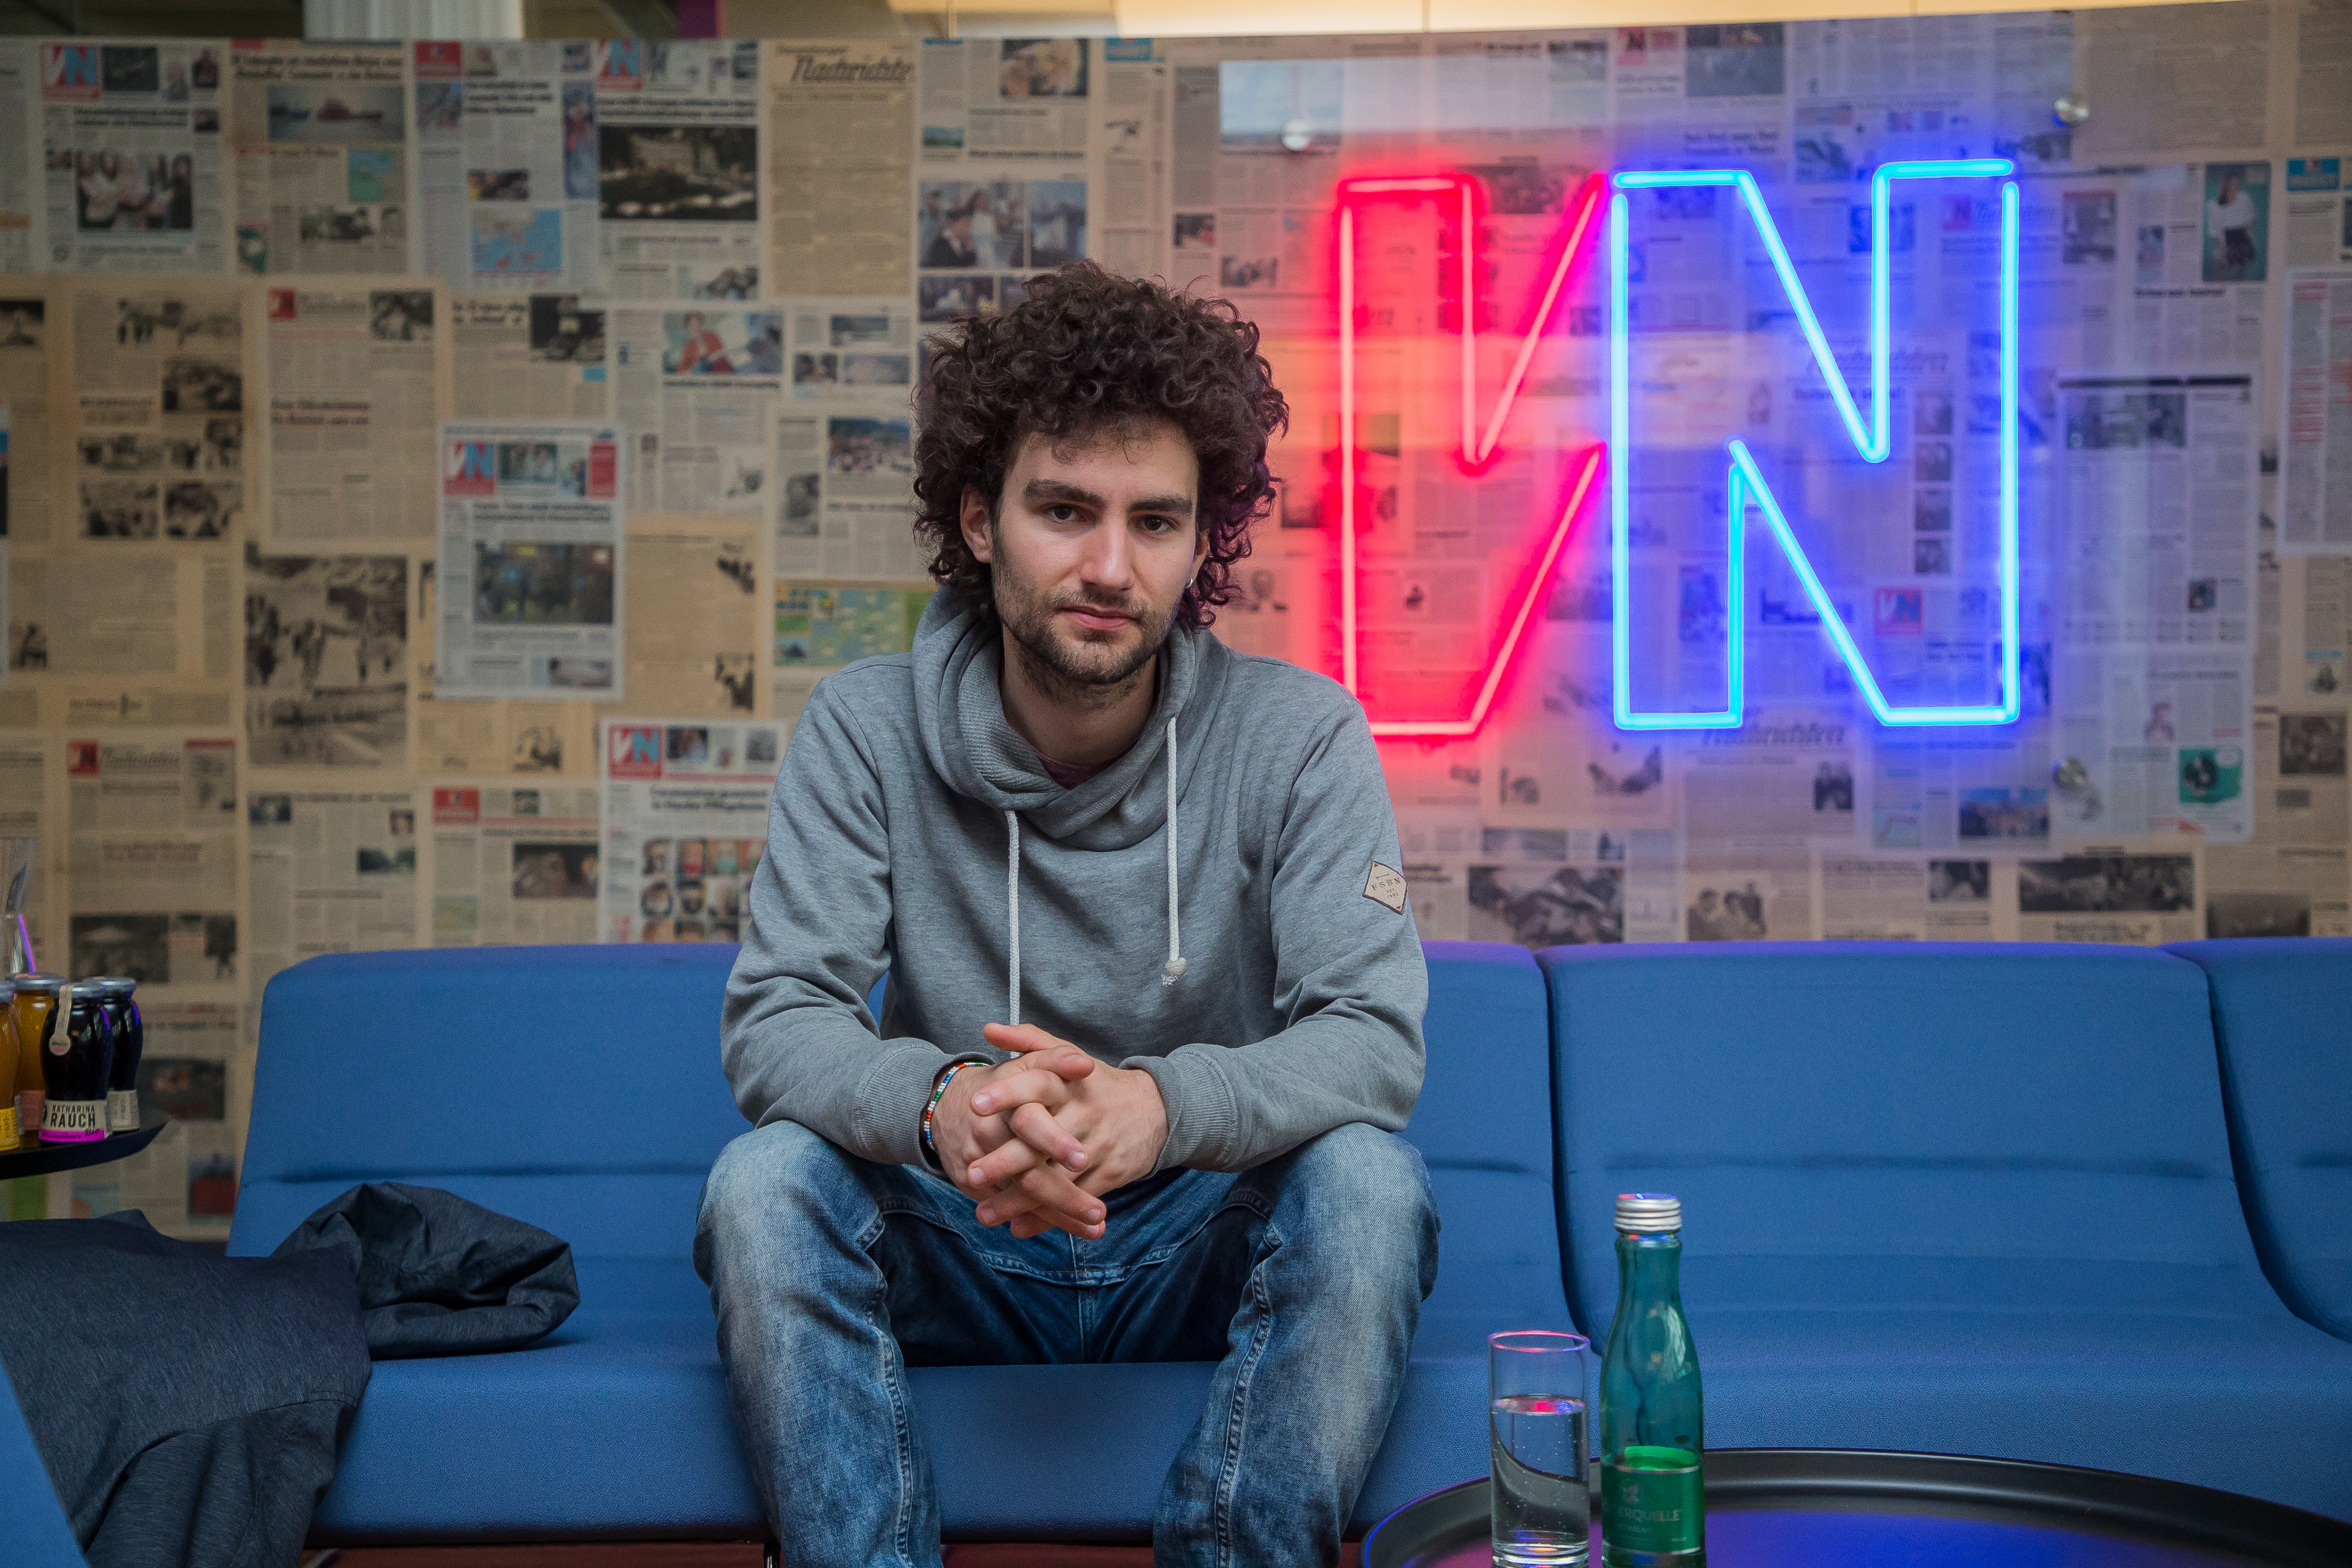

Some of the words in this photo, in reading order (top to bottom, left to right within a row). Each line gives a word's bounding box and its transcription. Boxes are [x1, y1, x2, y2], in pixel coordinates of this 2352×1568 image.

[1338, 158, 2021, 737] VN
[52, 1104, 95, 1113] KATHARINA
[50, 1113, 96, 1128] RAUCH
